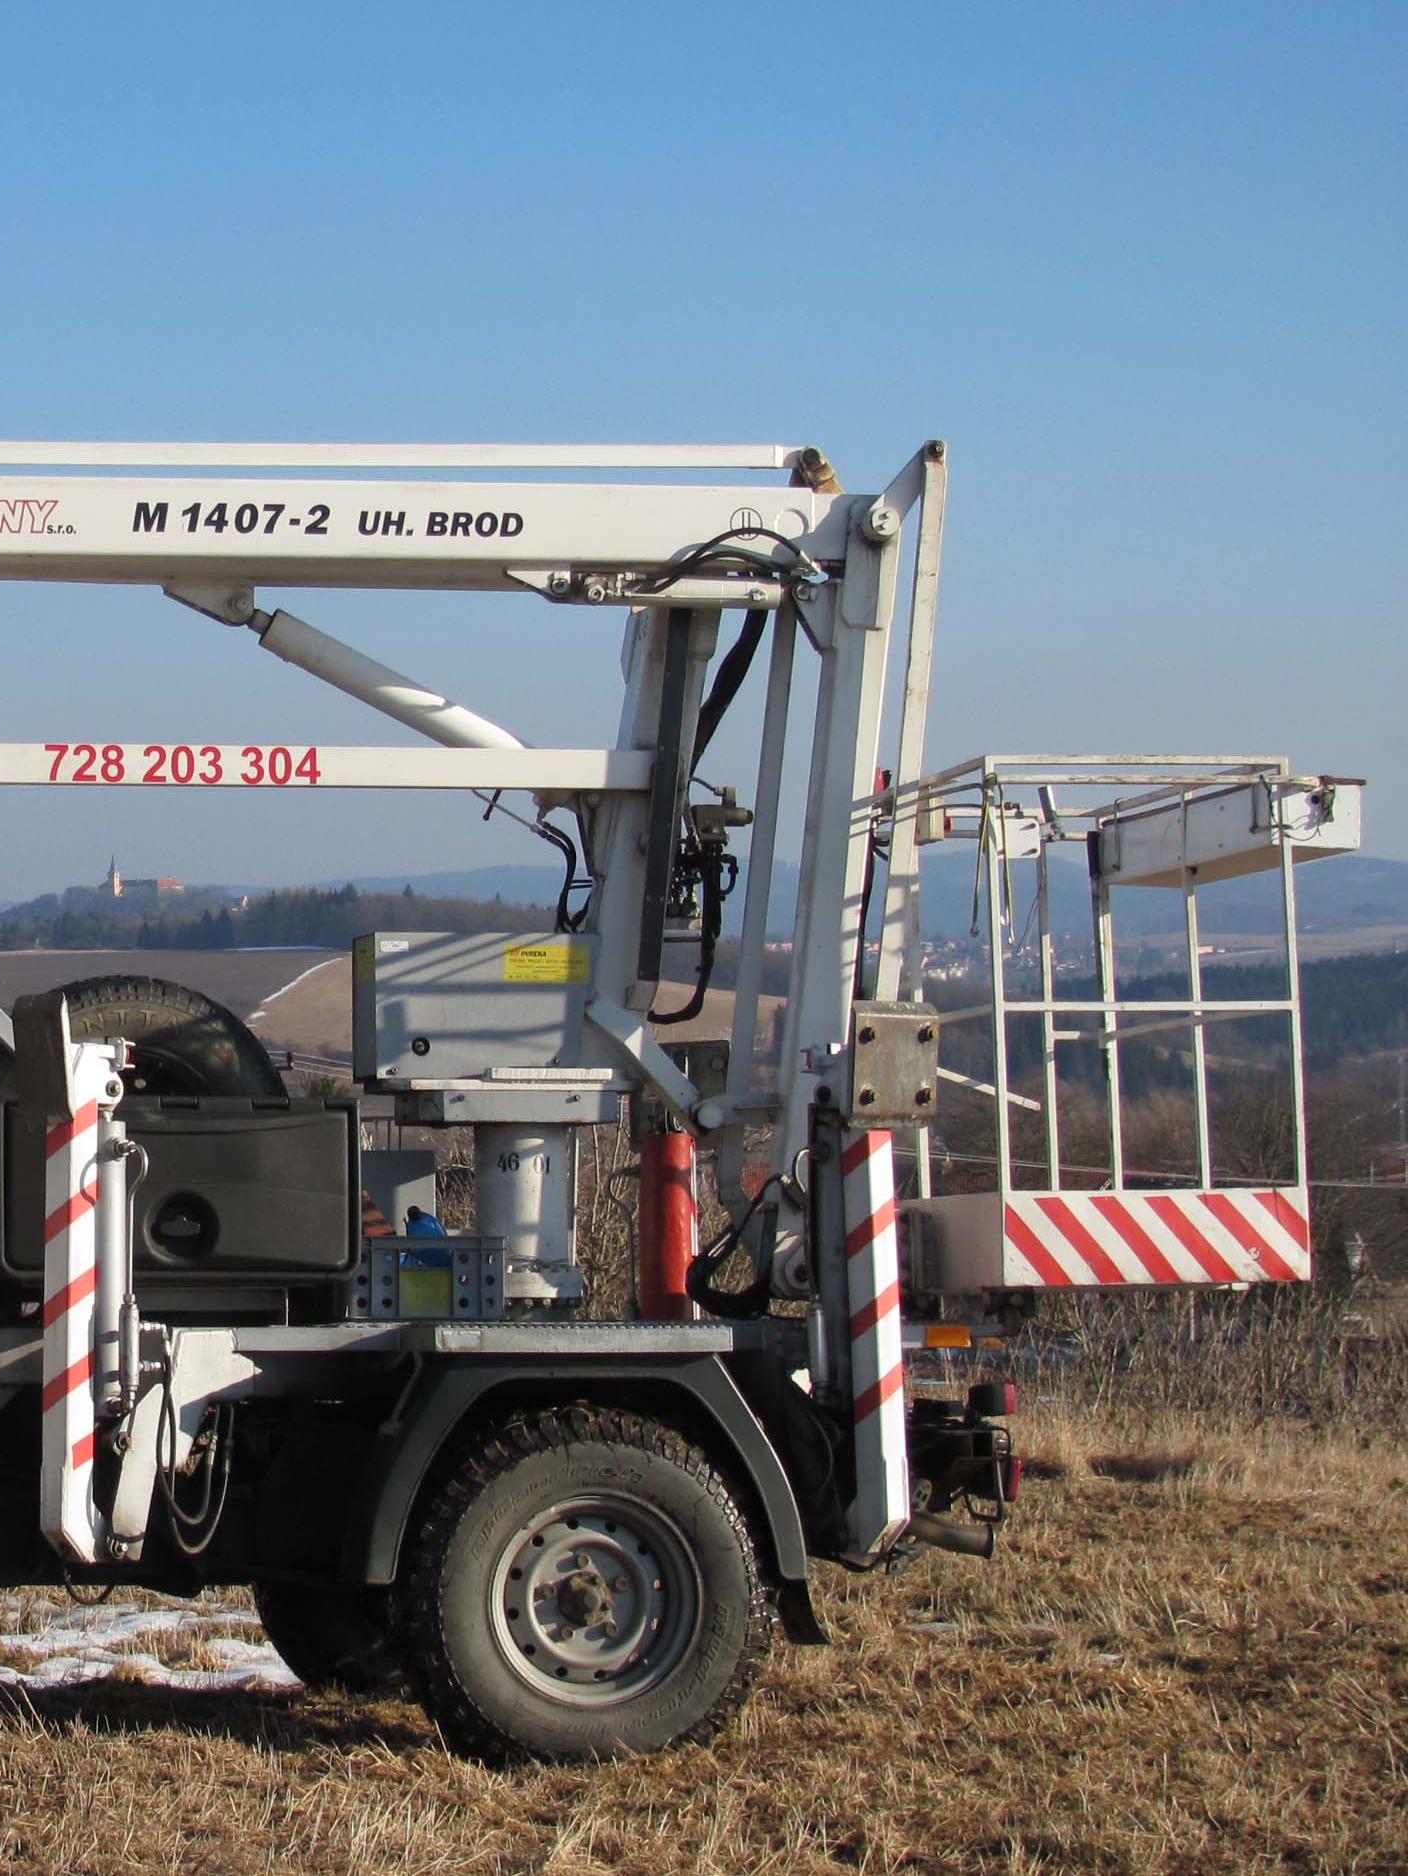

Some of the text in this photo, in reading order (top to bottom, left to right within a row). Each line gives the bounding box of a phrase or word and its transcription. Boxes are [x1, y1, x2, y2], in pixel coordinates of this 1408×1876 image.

[46, 523, 78, 535] s.r.o.
[132, 502, 524, 537] M 1407-2 UH. BROD
[44, 743, 322, 785] 728 203 304
